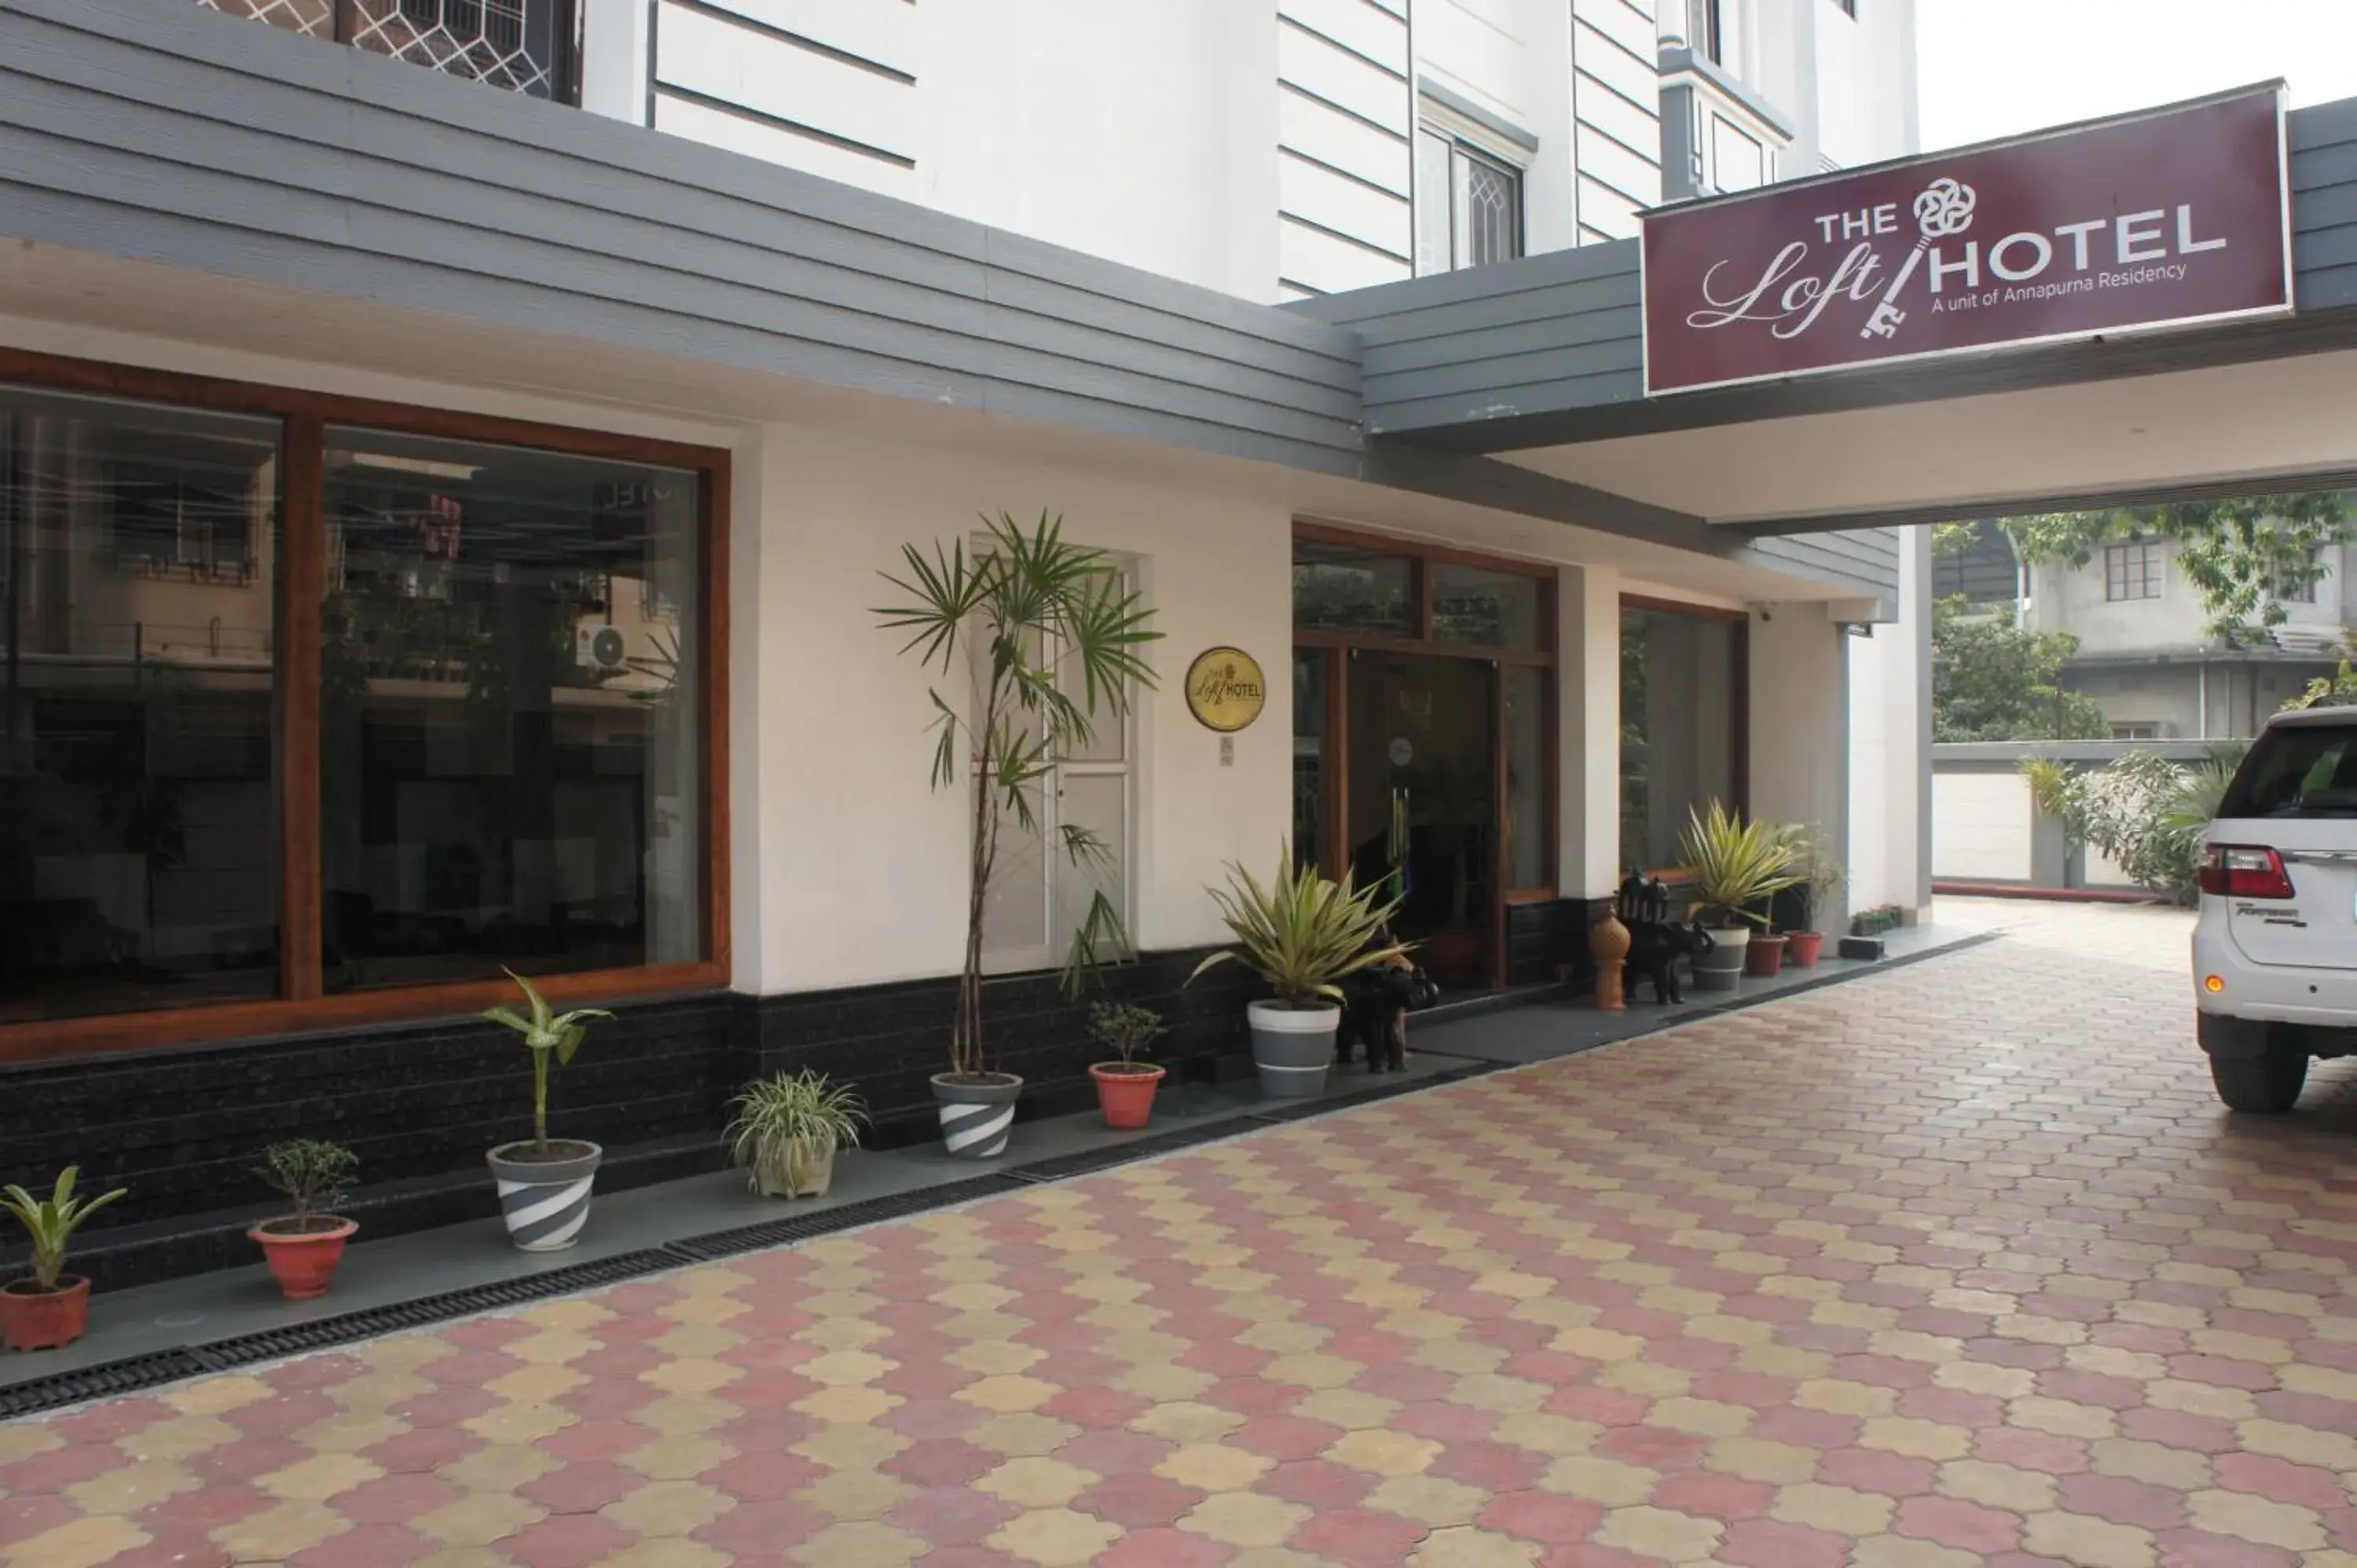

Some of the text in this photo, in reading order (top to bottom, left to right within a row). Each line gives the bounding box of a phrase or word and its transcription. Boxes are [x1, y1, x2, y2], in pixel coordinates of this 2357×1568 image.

[1814, 203, 1898, 244] THE
[1686, 203, 2227, 339] Loft HOTEL
[1931, 262, 2187, 313] A unit of Annapurna Residency
[1226, 683, 1261, 698] HOTEL
